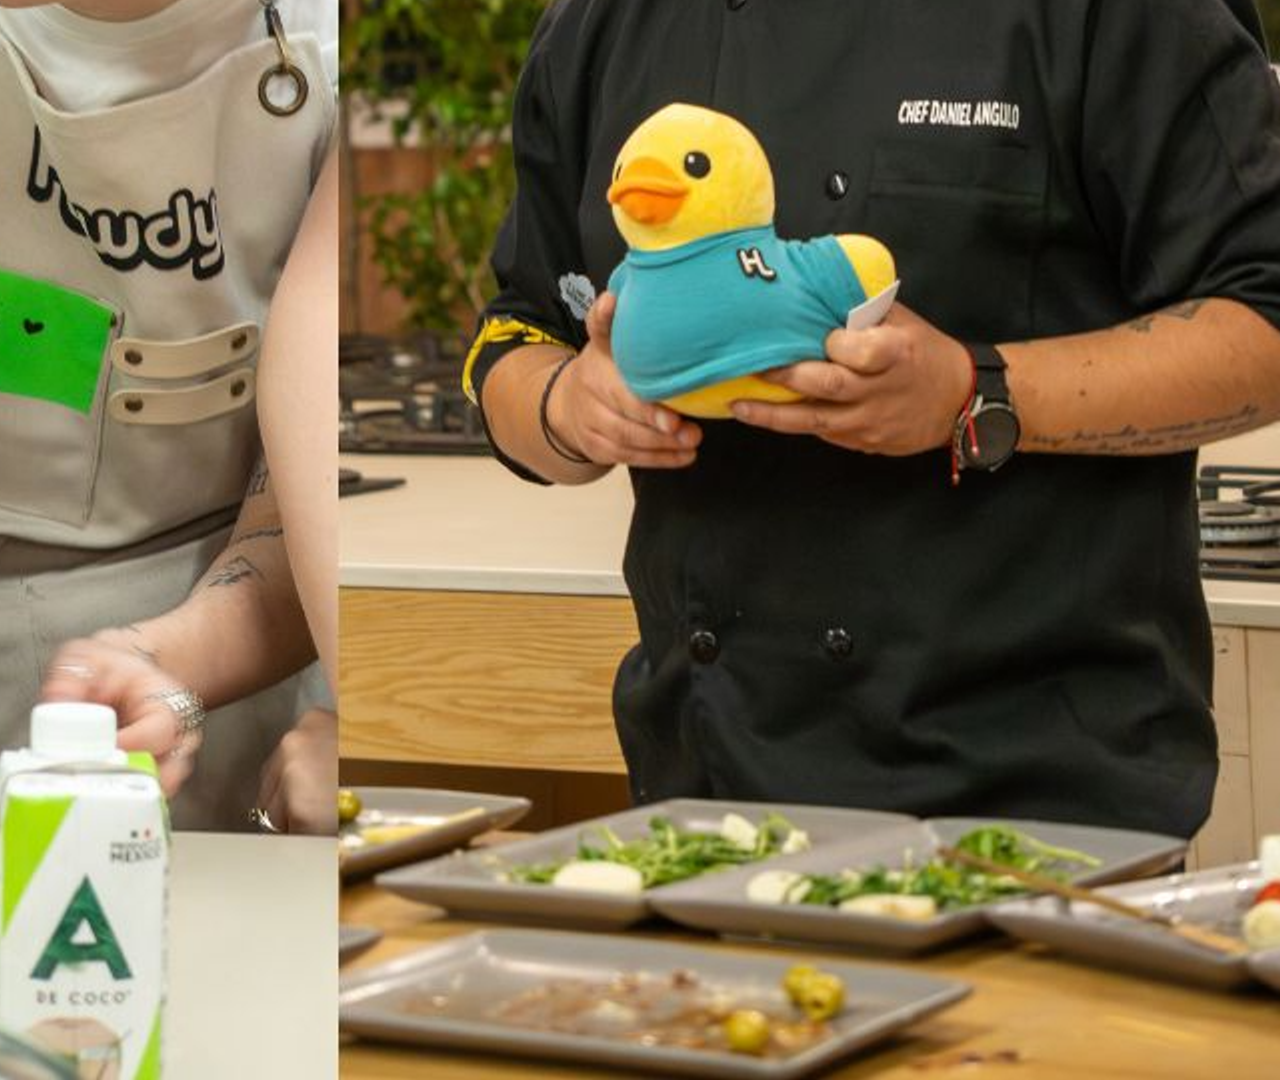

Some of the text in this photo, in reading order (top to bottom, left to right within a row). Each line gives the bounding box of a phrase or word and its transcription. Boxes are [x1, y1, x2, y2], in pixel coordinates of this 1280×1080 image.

[898, 100, 1019, 129] CHEF DANIEL ANGULO
[27, 123, 224, 280] wdy
[35, 989, 127, 1007] DE COCO
